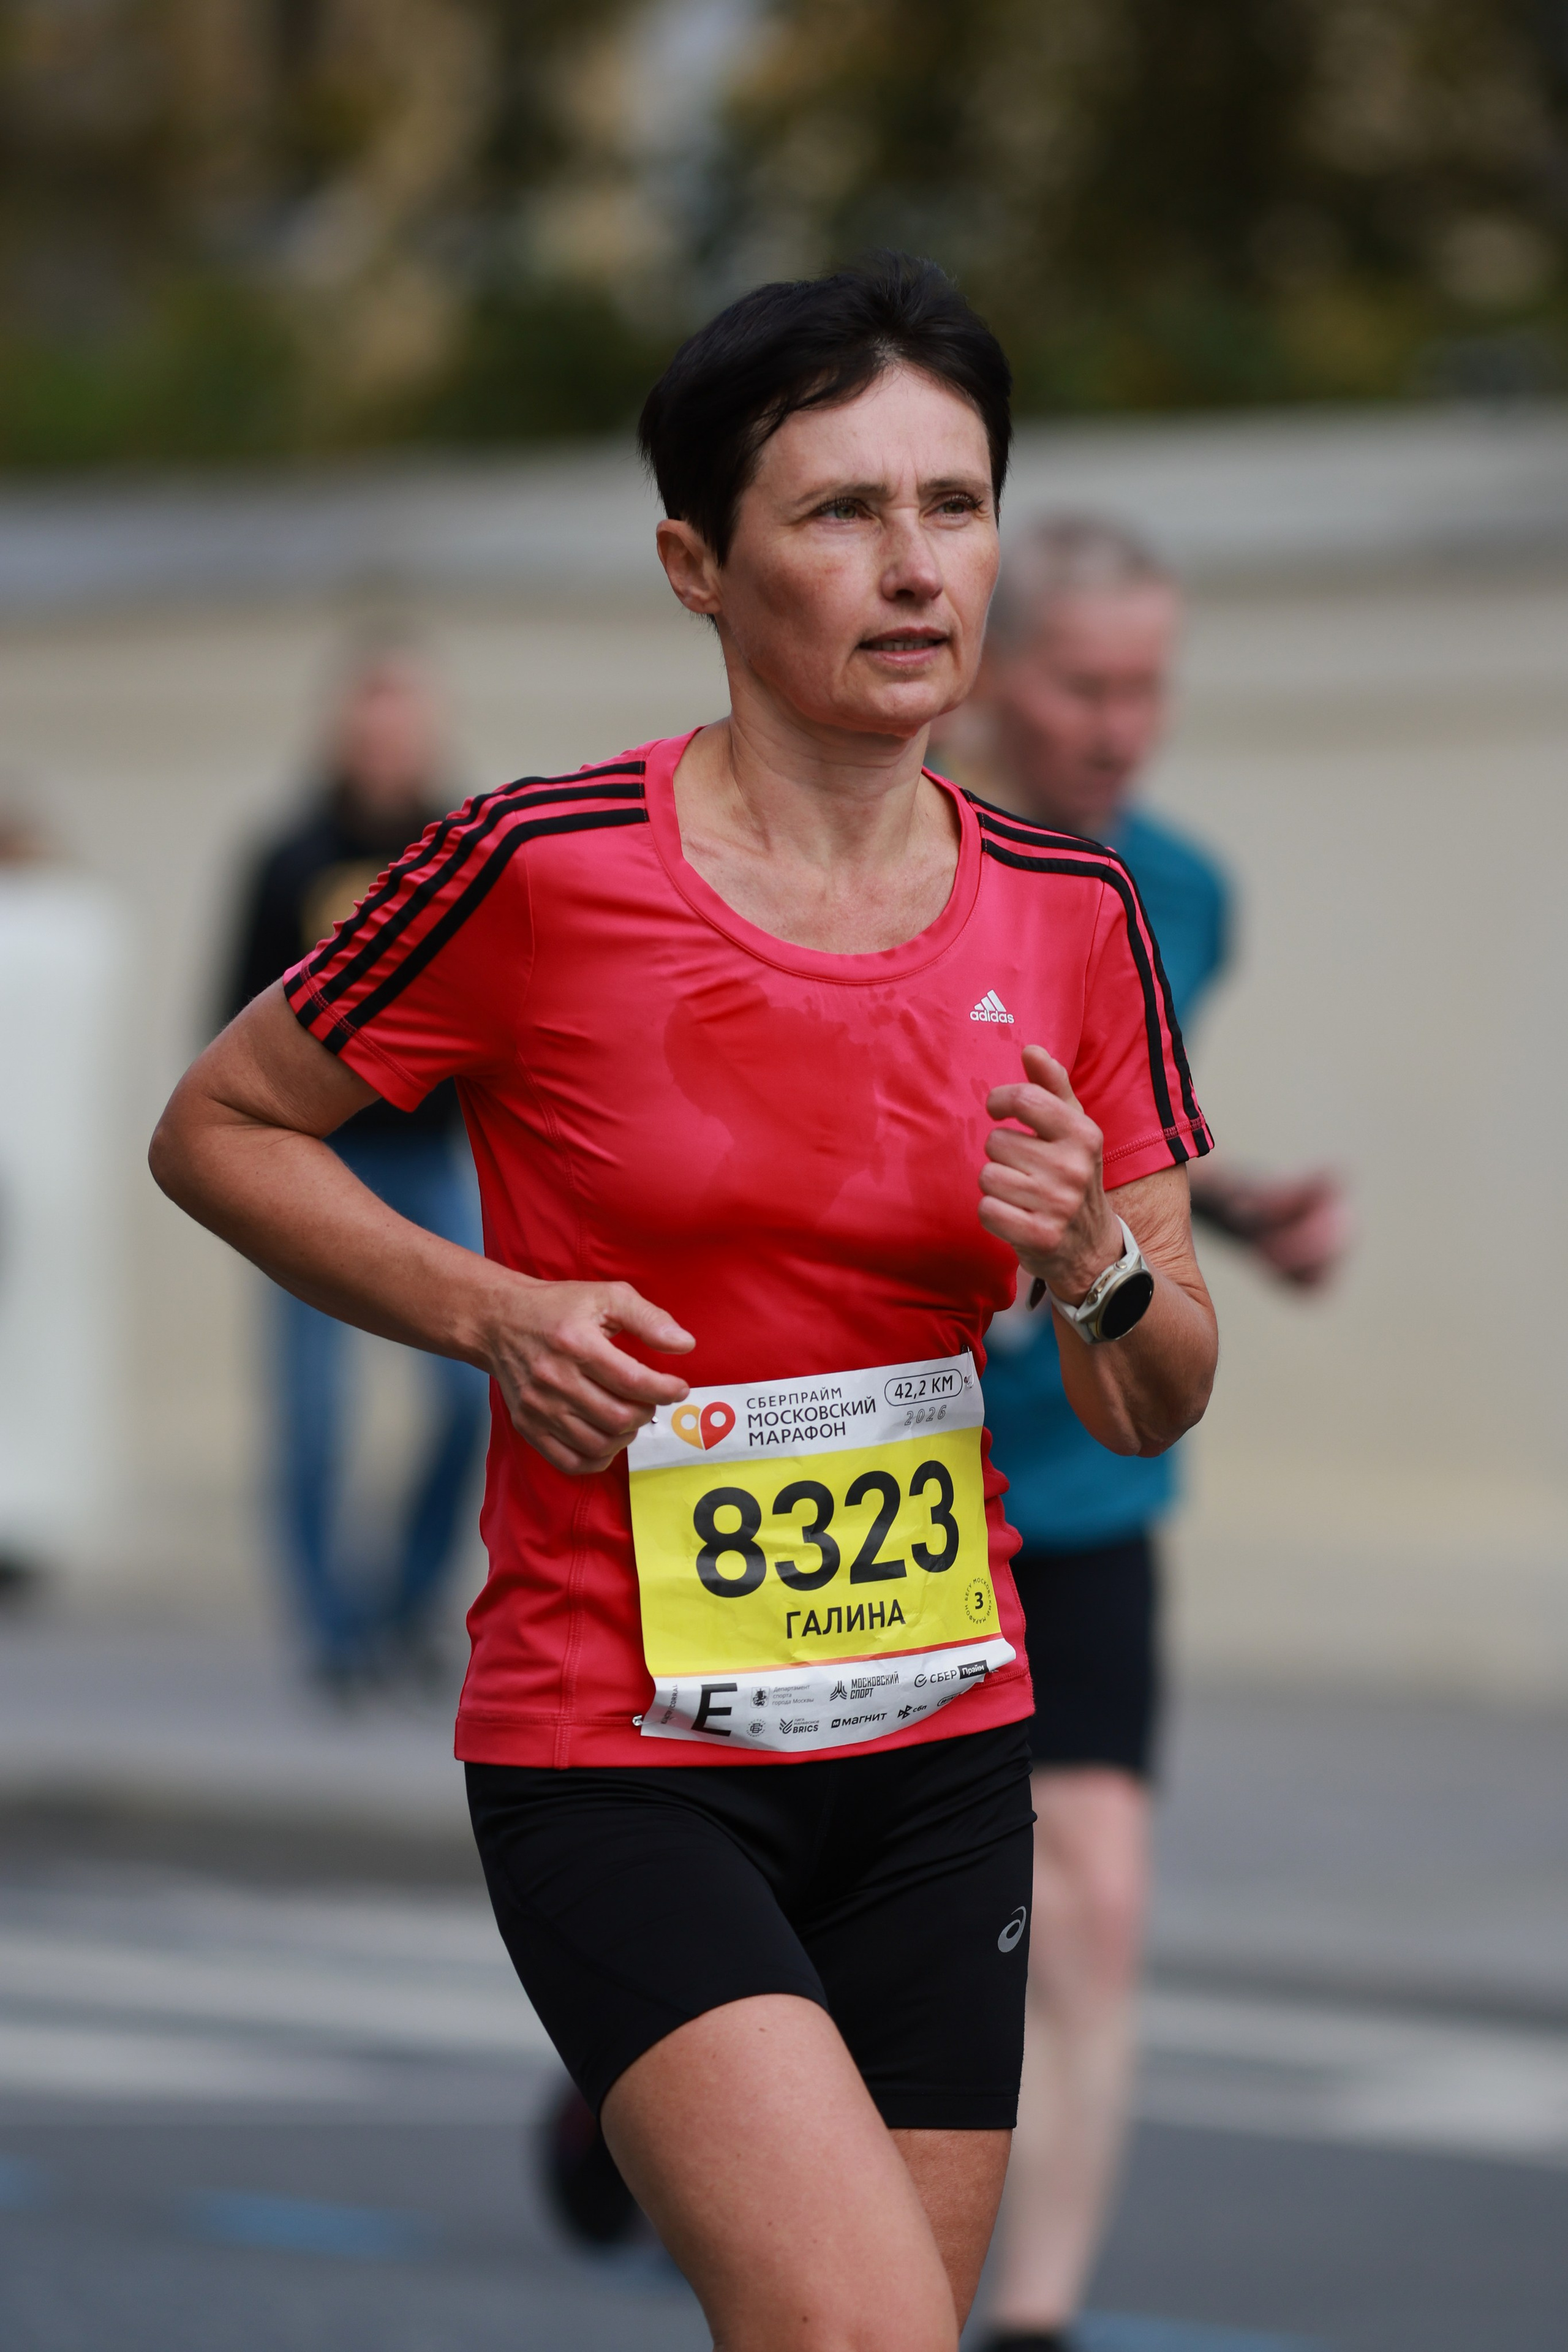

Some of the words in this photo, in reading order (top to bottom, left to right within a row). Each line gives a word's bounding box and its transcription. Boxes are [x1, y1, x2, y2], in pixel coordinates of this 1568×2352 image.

[970, 1009, 1014, 1023] adidas
[747, 1387, 842, 1409] СБЕРПРАЙМ
[894, 1380, 926, 1399] 42,2
[747, 1396, 876, 1428] МОСКОВСКИЙ
[904, 1404, 947, 1426] 2026
[749, 1421, 846, 1446] МАРАФОН
[693, 1460, 959, 1598] 8323
[974, 1591, 984, 1610] 3
[786, 1599, 906, 1638] ГАЛИНА
[851, 1671, 899, 1689] МОСКОВСКИЙ
[930, 1670, 957, 1683] СБЕР
[962, 1664, 984, 1675] Прайм
[850, 1687, 873, 1699] СПОРТ
[793, 1724, 819, 1733] BRICS
